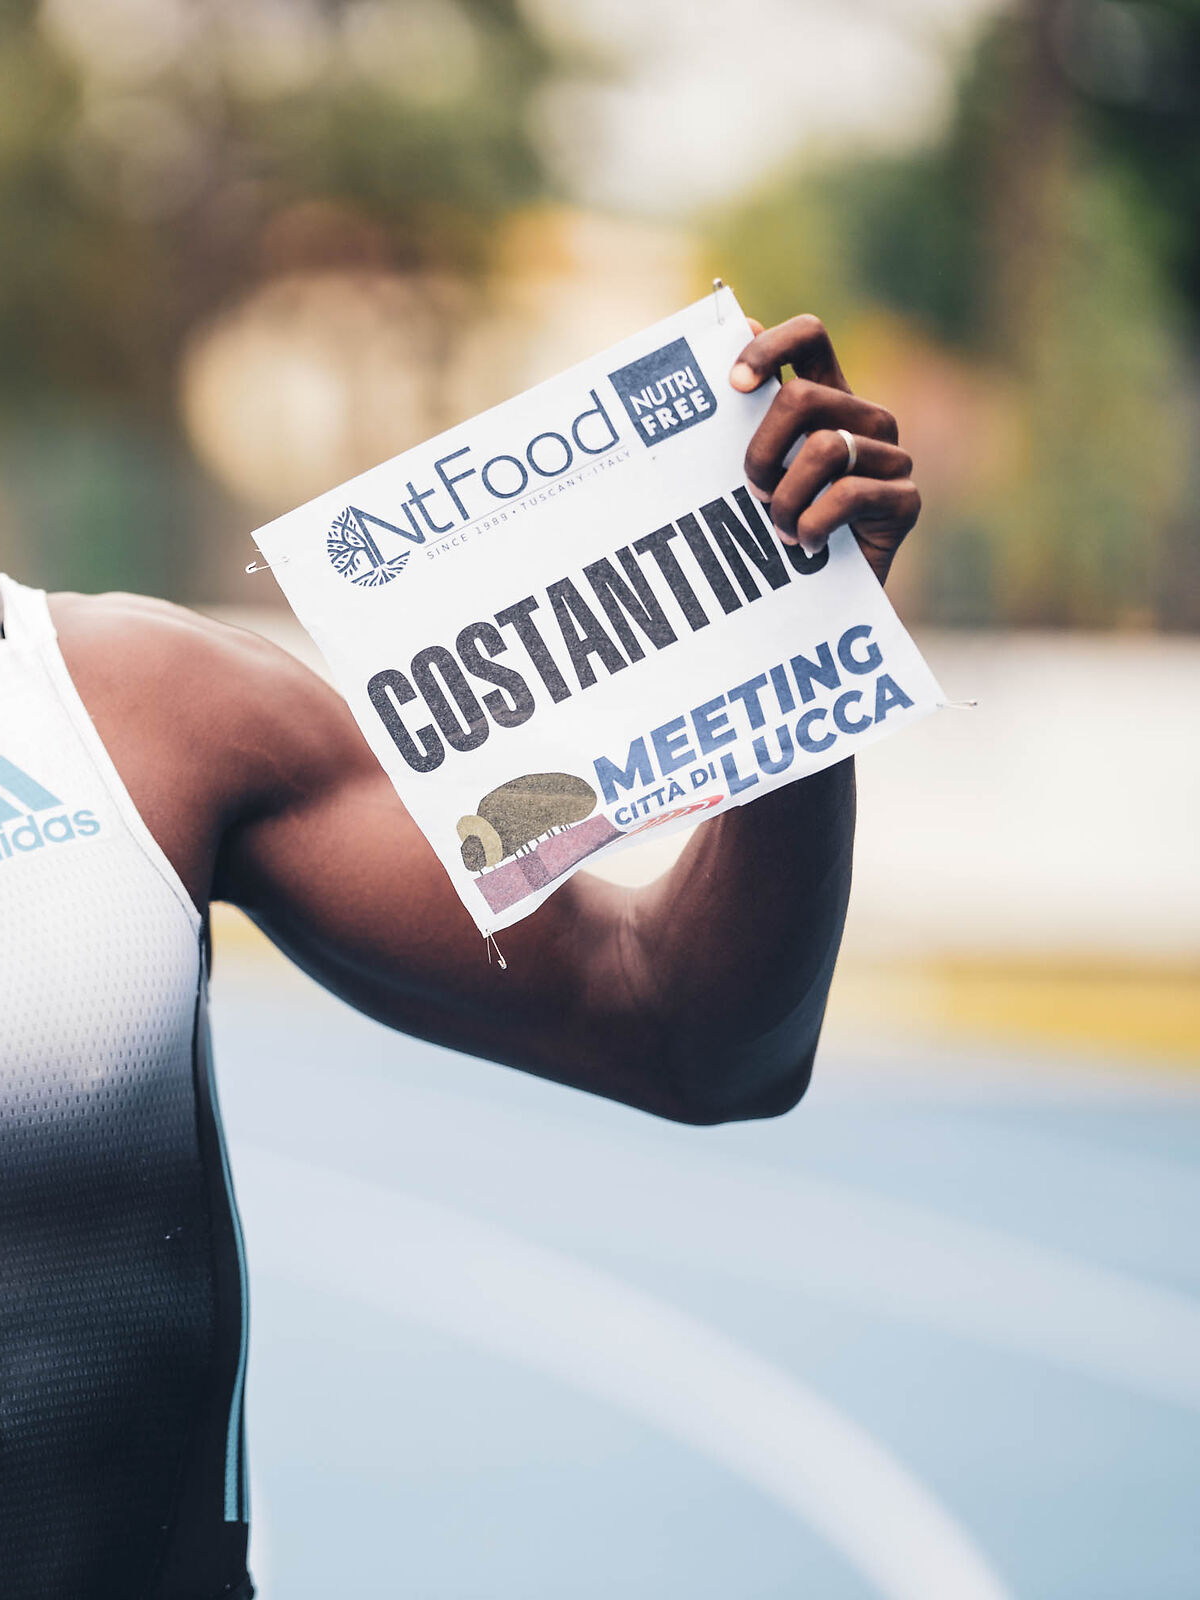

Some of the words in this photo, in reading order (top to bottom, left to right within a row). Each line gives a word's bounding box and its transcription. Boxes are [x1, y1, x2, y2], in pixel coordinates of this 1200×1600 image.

[629, 366, 699, 415] NUTRI
[640, 389, 711, 437] FREE
[348, 388, 620, 569] NtFood
[426, 532, 469, 560] SINCE
[475, 513, 509, 536] 1989
[520, 473, 584, 511] TUSCANY
[592, 449, 632, 474] ITALY
[592, 624, 884, 806] MEETING
[614, 777, 687, 826] CITTÀ
[689, 761, 718, 791] DI
[719, 673, 915, 797] LUCCA
